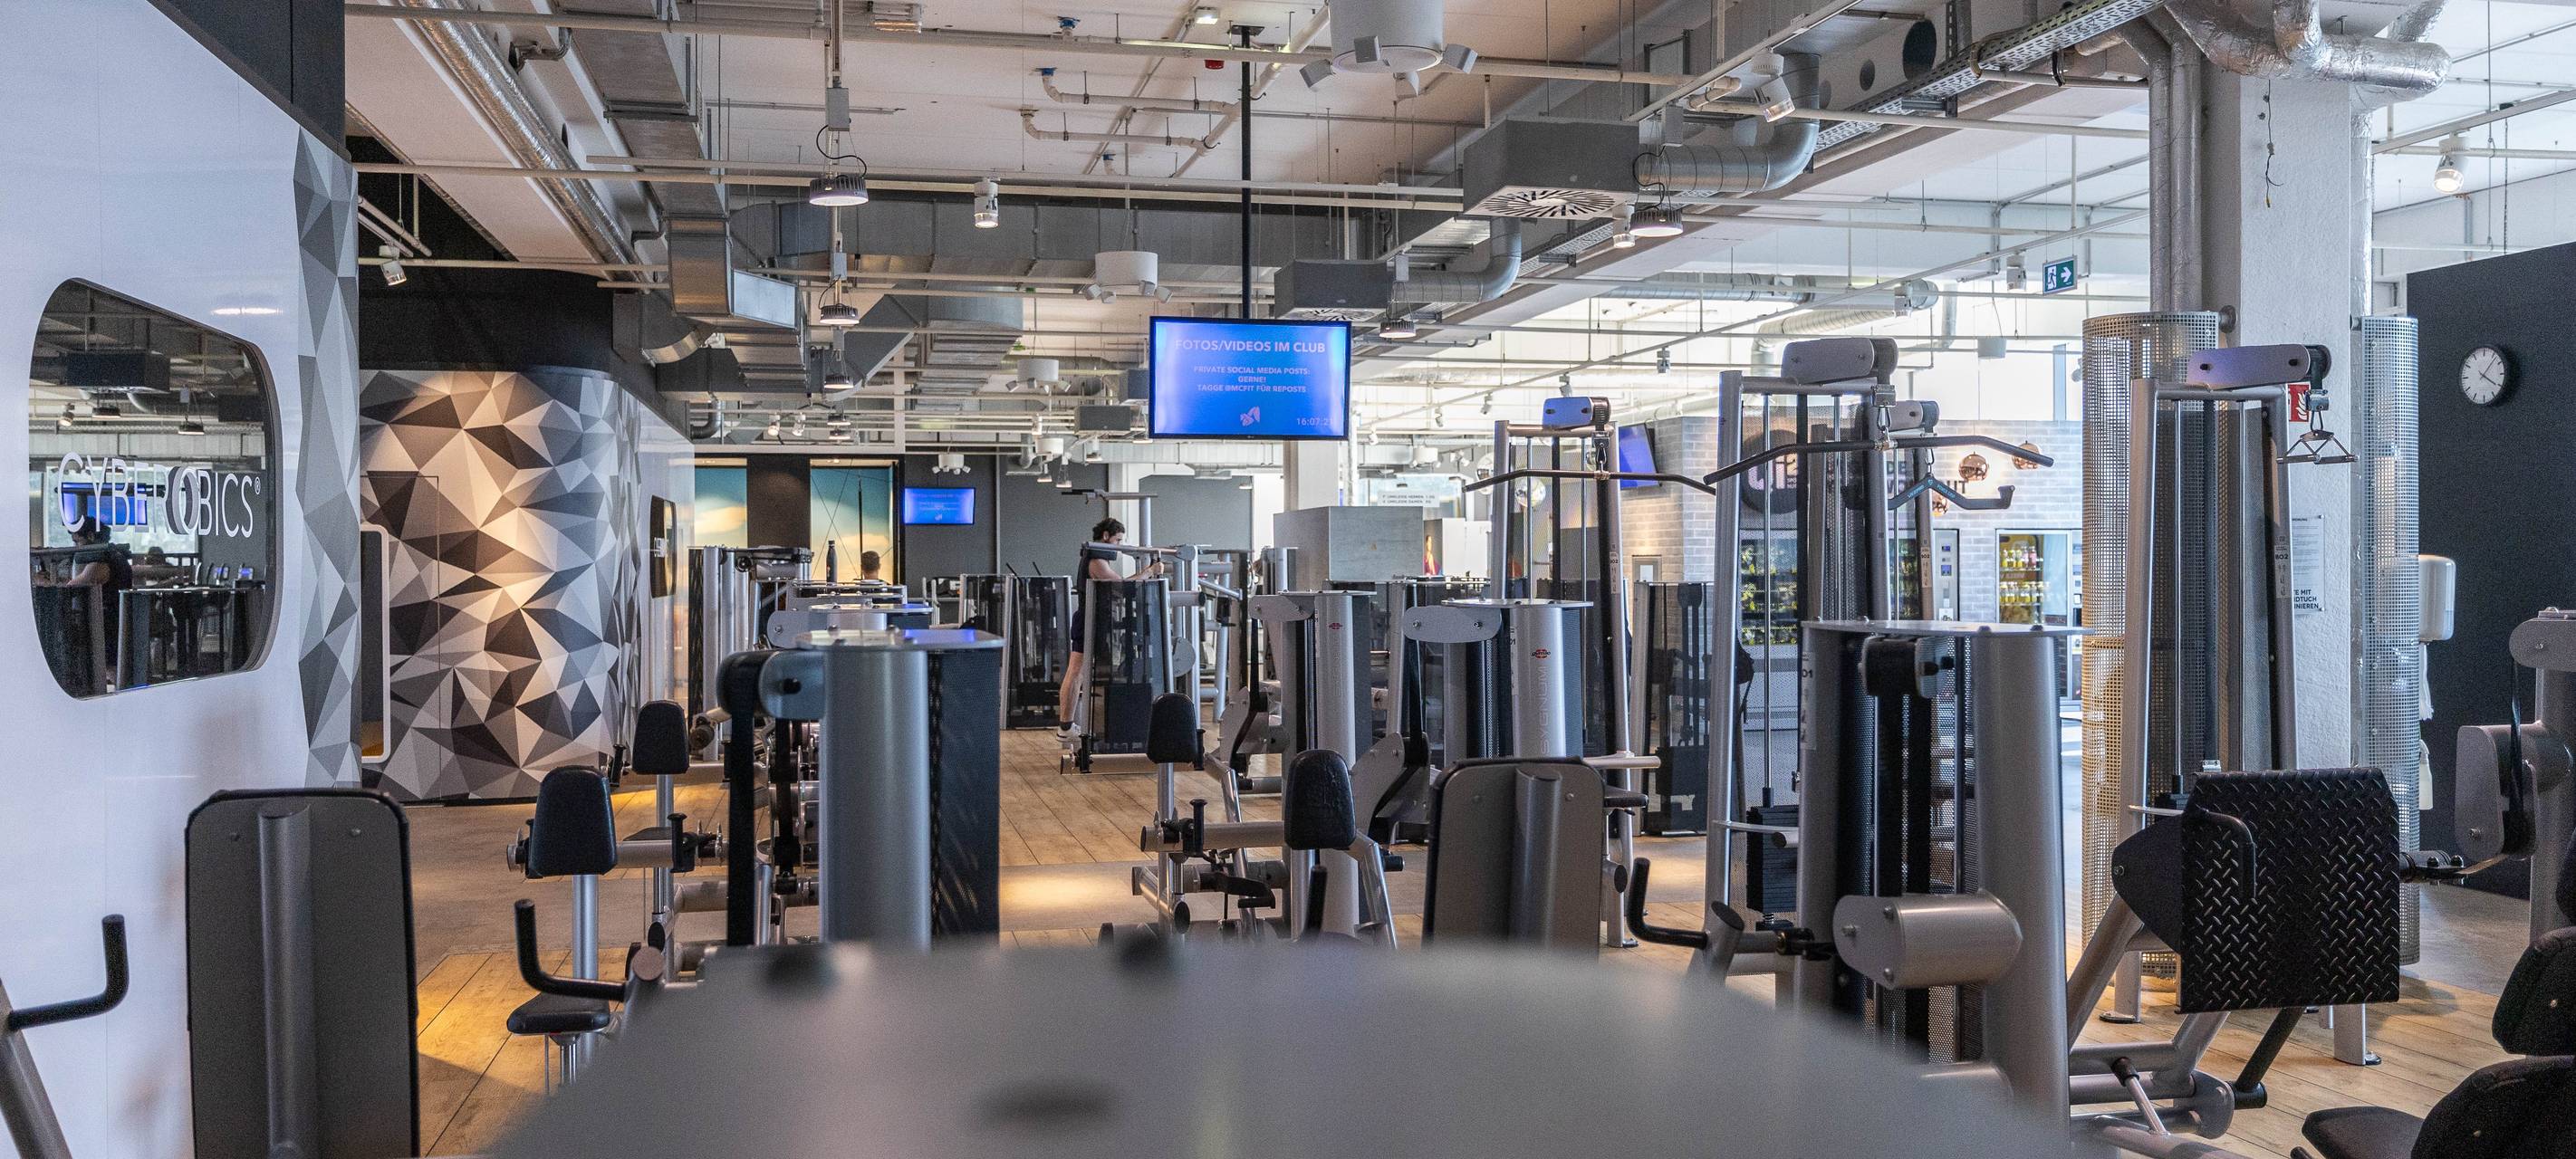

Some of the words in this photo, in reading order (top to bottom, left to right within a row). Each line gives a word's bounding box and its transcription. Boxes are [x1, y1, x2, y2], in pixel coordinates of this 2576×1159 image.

[1177, 340, 1271, 352] FOTOS/VIDEOS
[1274, 341, 1290, 352] IM
[1293, 341, 1326, 353] CLUB
[1194, 366, 1226, 374] PRIVATE
[1226, 366, 1256, 374] SOCIAL
[1257, 367, 1282, 375] MEDIA
[1197, 384, 1223, 392] TAGGE
[1256, 383, 1271, 392] FÜR
[1273, 385, 1306, 393] REPOSTS
